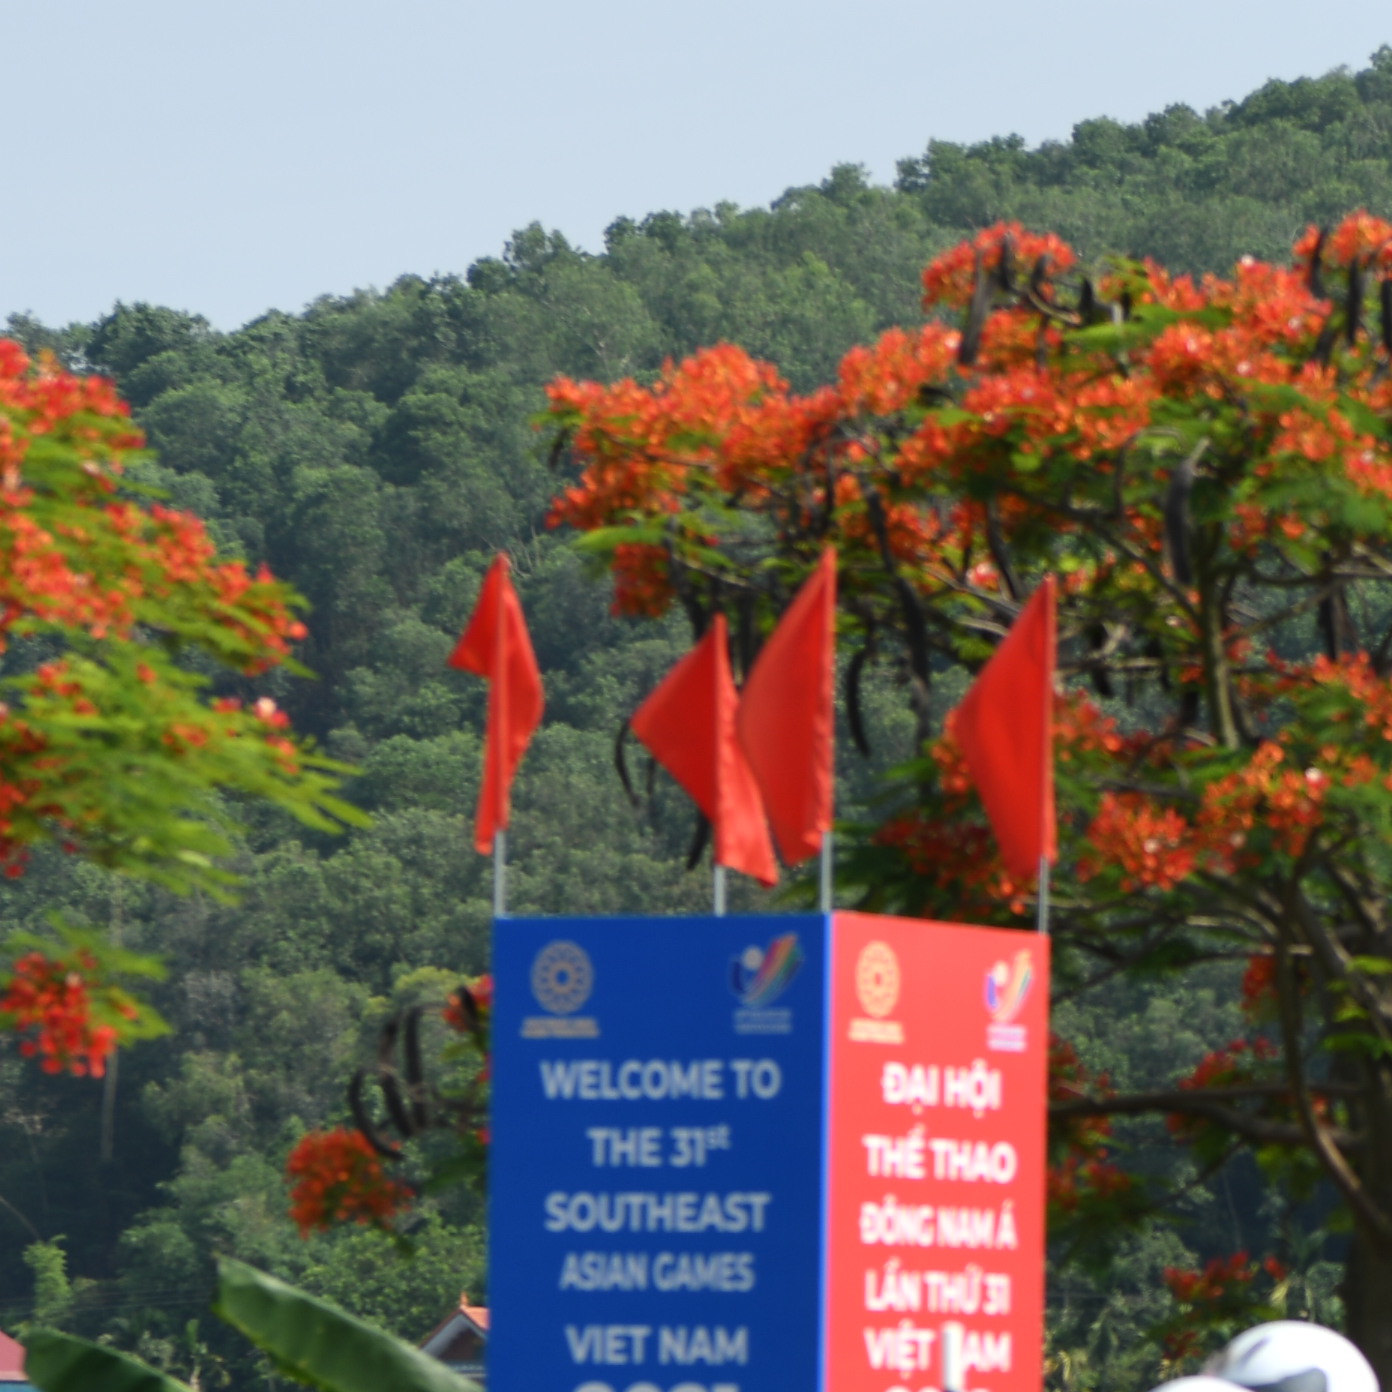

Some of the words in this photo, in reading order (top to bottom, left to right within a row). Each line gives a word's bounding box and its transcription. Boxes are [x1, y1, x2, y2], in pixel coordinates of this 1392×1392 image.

[540, 1059, 724, 1100] WELCOME
[730, 1059, 781, 1100] TO
[881, 1061, 939, 1115] ĐẠI
[943, 1058, 1002, 1119] HỘI
[586, 1127, 662, 1167] THE
[669, 1121, 731, 1167] 31st
[928, 1137, 1018, 1184] THAO
[544, 1191, 772, 1232] SOUTHEAST
[859, 1193, 934, 1247] ĐÔNG
[936, 1206, 995, 1249] NAM
[995, 1199, 1018, 1250] Á
[559, 1252, 648, 1291] ASIAN
[652, 1252, 755, 1292] GAMES
[983, 1272, 1011, 1315] 31
[564, 1324, 651, 1365] VIET
[658, 1325, 749, 1366] NAM
[863, 1318, 935, 1380] VIỆT
[946, 1329, 1012, 1373] AM
